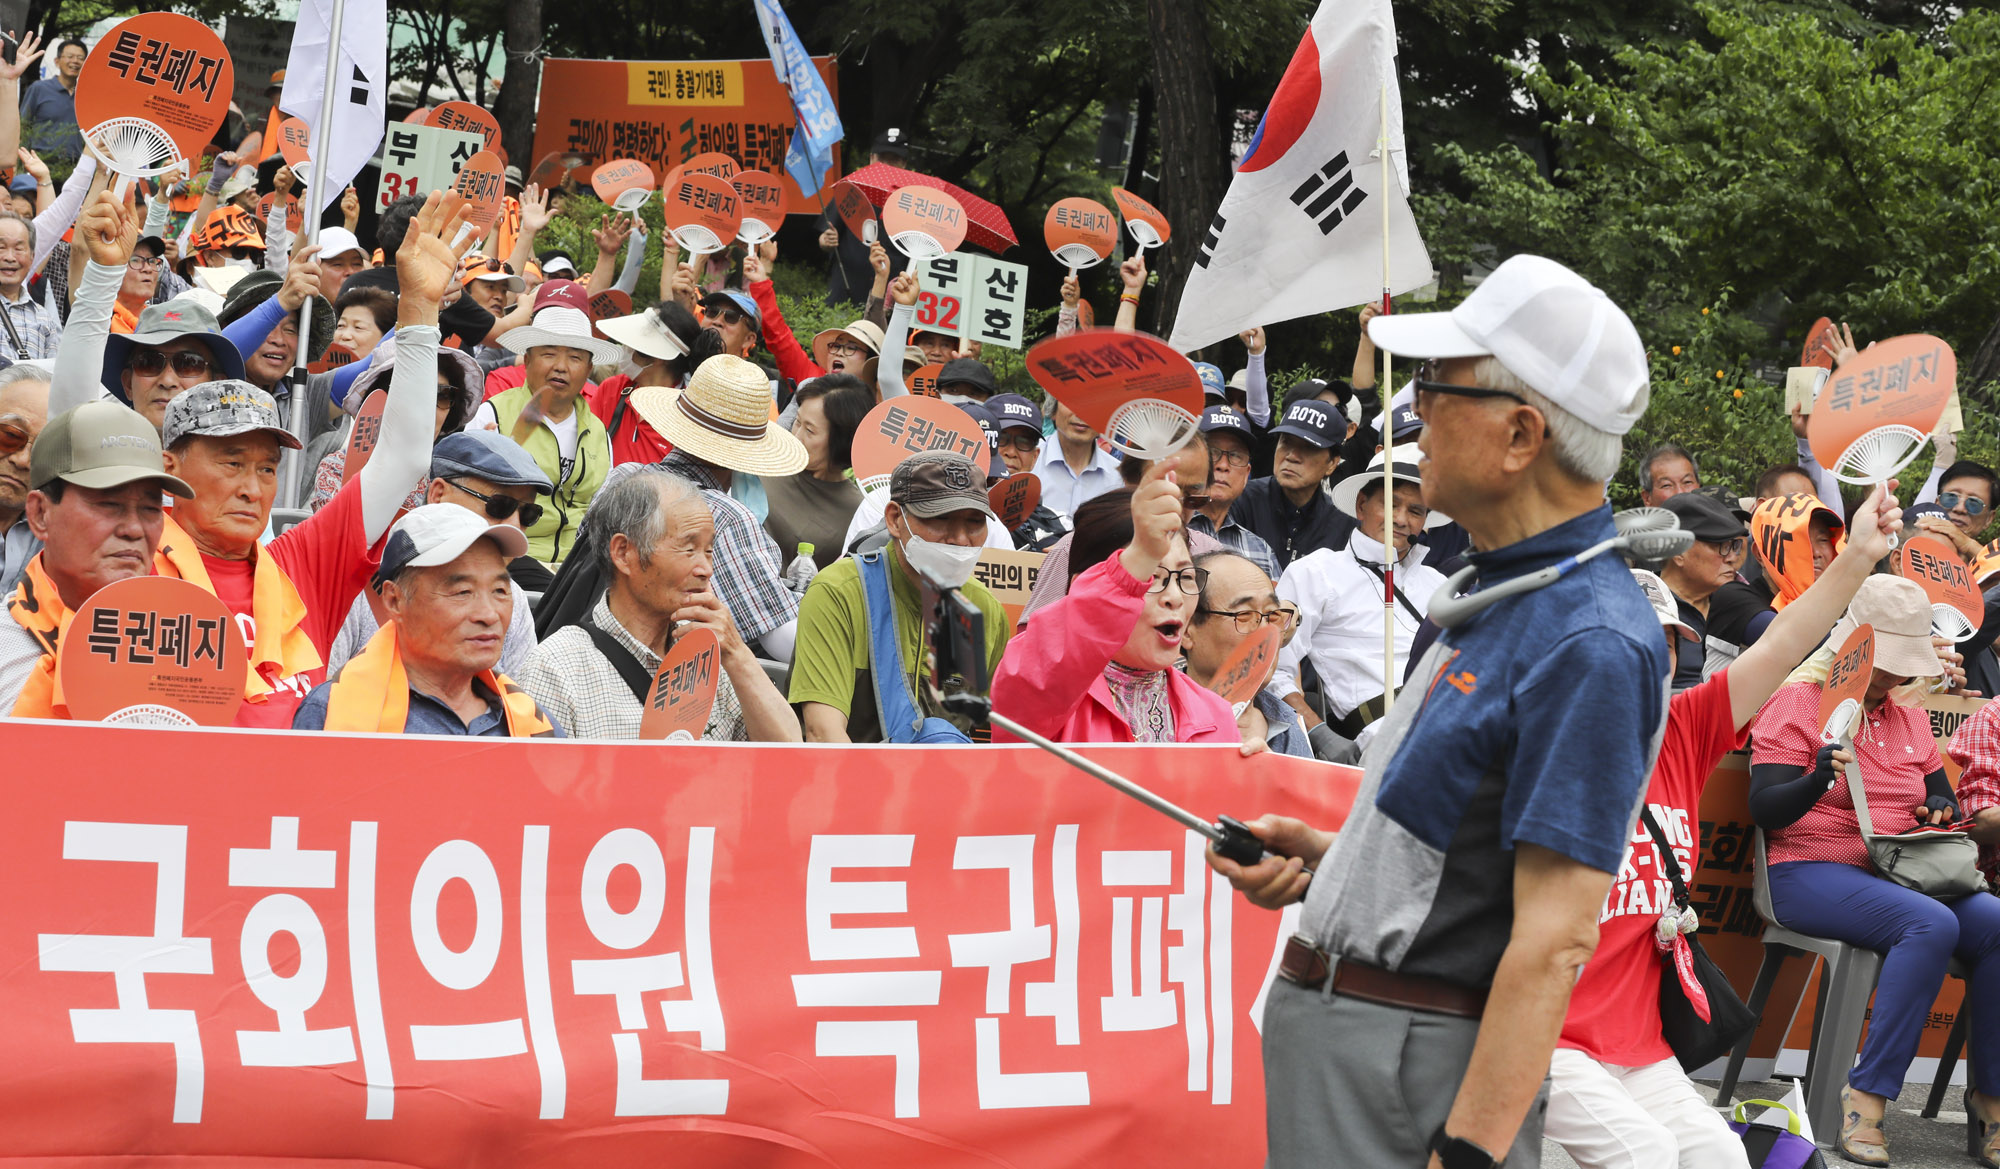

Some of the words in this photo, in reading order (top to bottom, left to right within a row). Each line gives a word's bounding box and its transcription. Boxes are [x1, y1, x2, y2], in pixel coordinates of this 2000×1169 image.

[108, 30, 225, 103] 특권폐지
[647, 70, 672, 98] 국민!
[675, 69, 725, 99] 총궐기대회
[285, 127, 309, 148] 특권
[438, 107, 498, 148] 특권폐지
[389, 131, 418, 166] 부
[381, 172, 418, 207] 31
[457, 169, 502, 203] 특권폐지
[596, 162, 643, 185] 특권폐지
[678, 182, 737, 218] 특권폐지
[733, 181, 781, 206] 특권폐지
[898, 191, 962, 228] 특권폐지
[1055, 207, 1110, 233] 특권폐지
[928, 255, 958, 288] 부
[985, 268, 1019, 302] 산
[916, 291, 961, 330] 32
[981, 308, 1012, 341] 호
[1037, 336, 1168, 383] 특권폐지
[912, 377, 937, 398] 특권
[1829, 345, 1942, 412] 특권폐지
[1003, 403, 1033, 418] ROTC
[1210, 413, 1241, 428] ROTC
[1288, 405, 1328, 429] ROTC
[1403, 411, 1419, 423] RO
[354, 415, 383, 453] 특권폐
[879, 406, 983, 462] 특권폐지
[984, 429, 998, 449] TC
[974, 561, 1022, 591] 국민의
[1909, 548, 1971, 593] 특권폐지
[88, 607, 227, 670] 특권폐지
[654, 643, 715, 713] 특권폐지
[1829, 633, 1872, 690] 특권폐지
[1926, 710, 1970, 738] 령이
[1600, 879, 1675, 924] LIAN
[38, 817, 730, 1124] 국회의원
[791, 822, 1233, 1119] 특권폐
